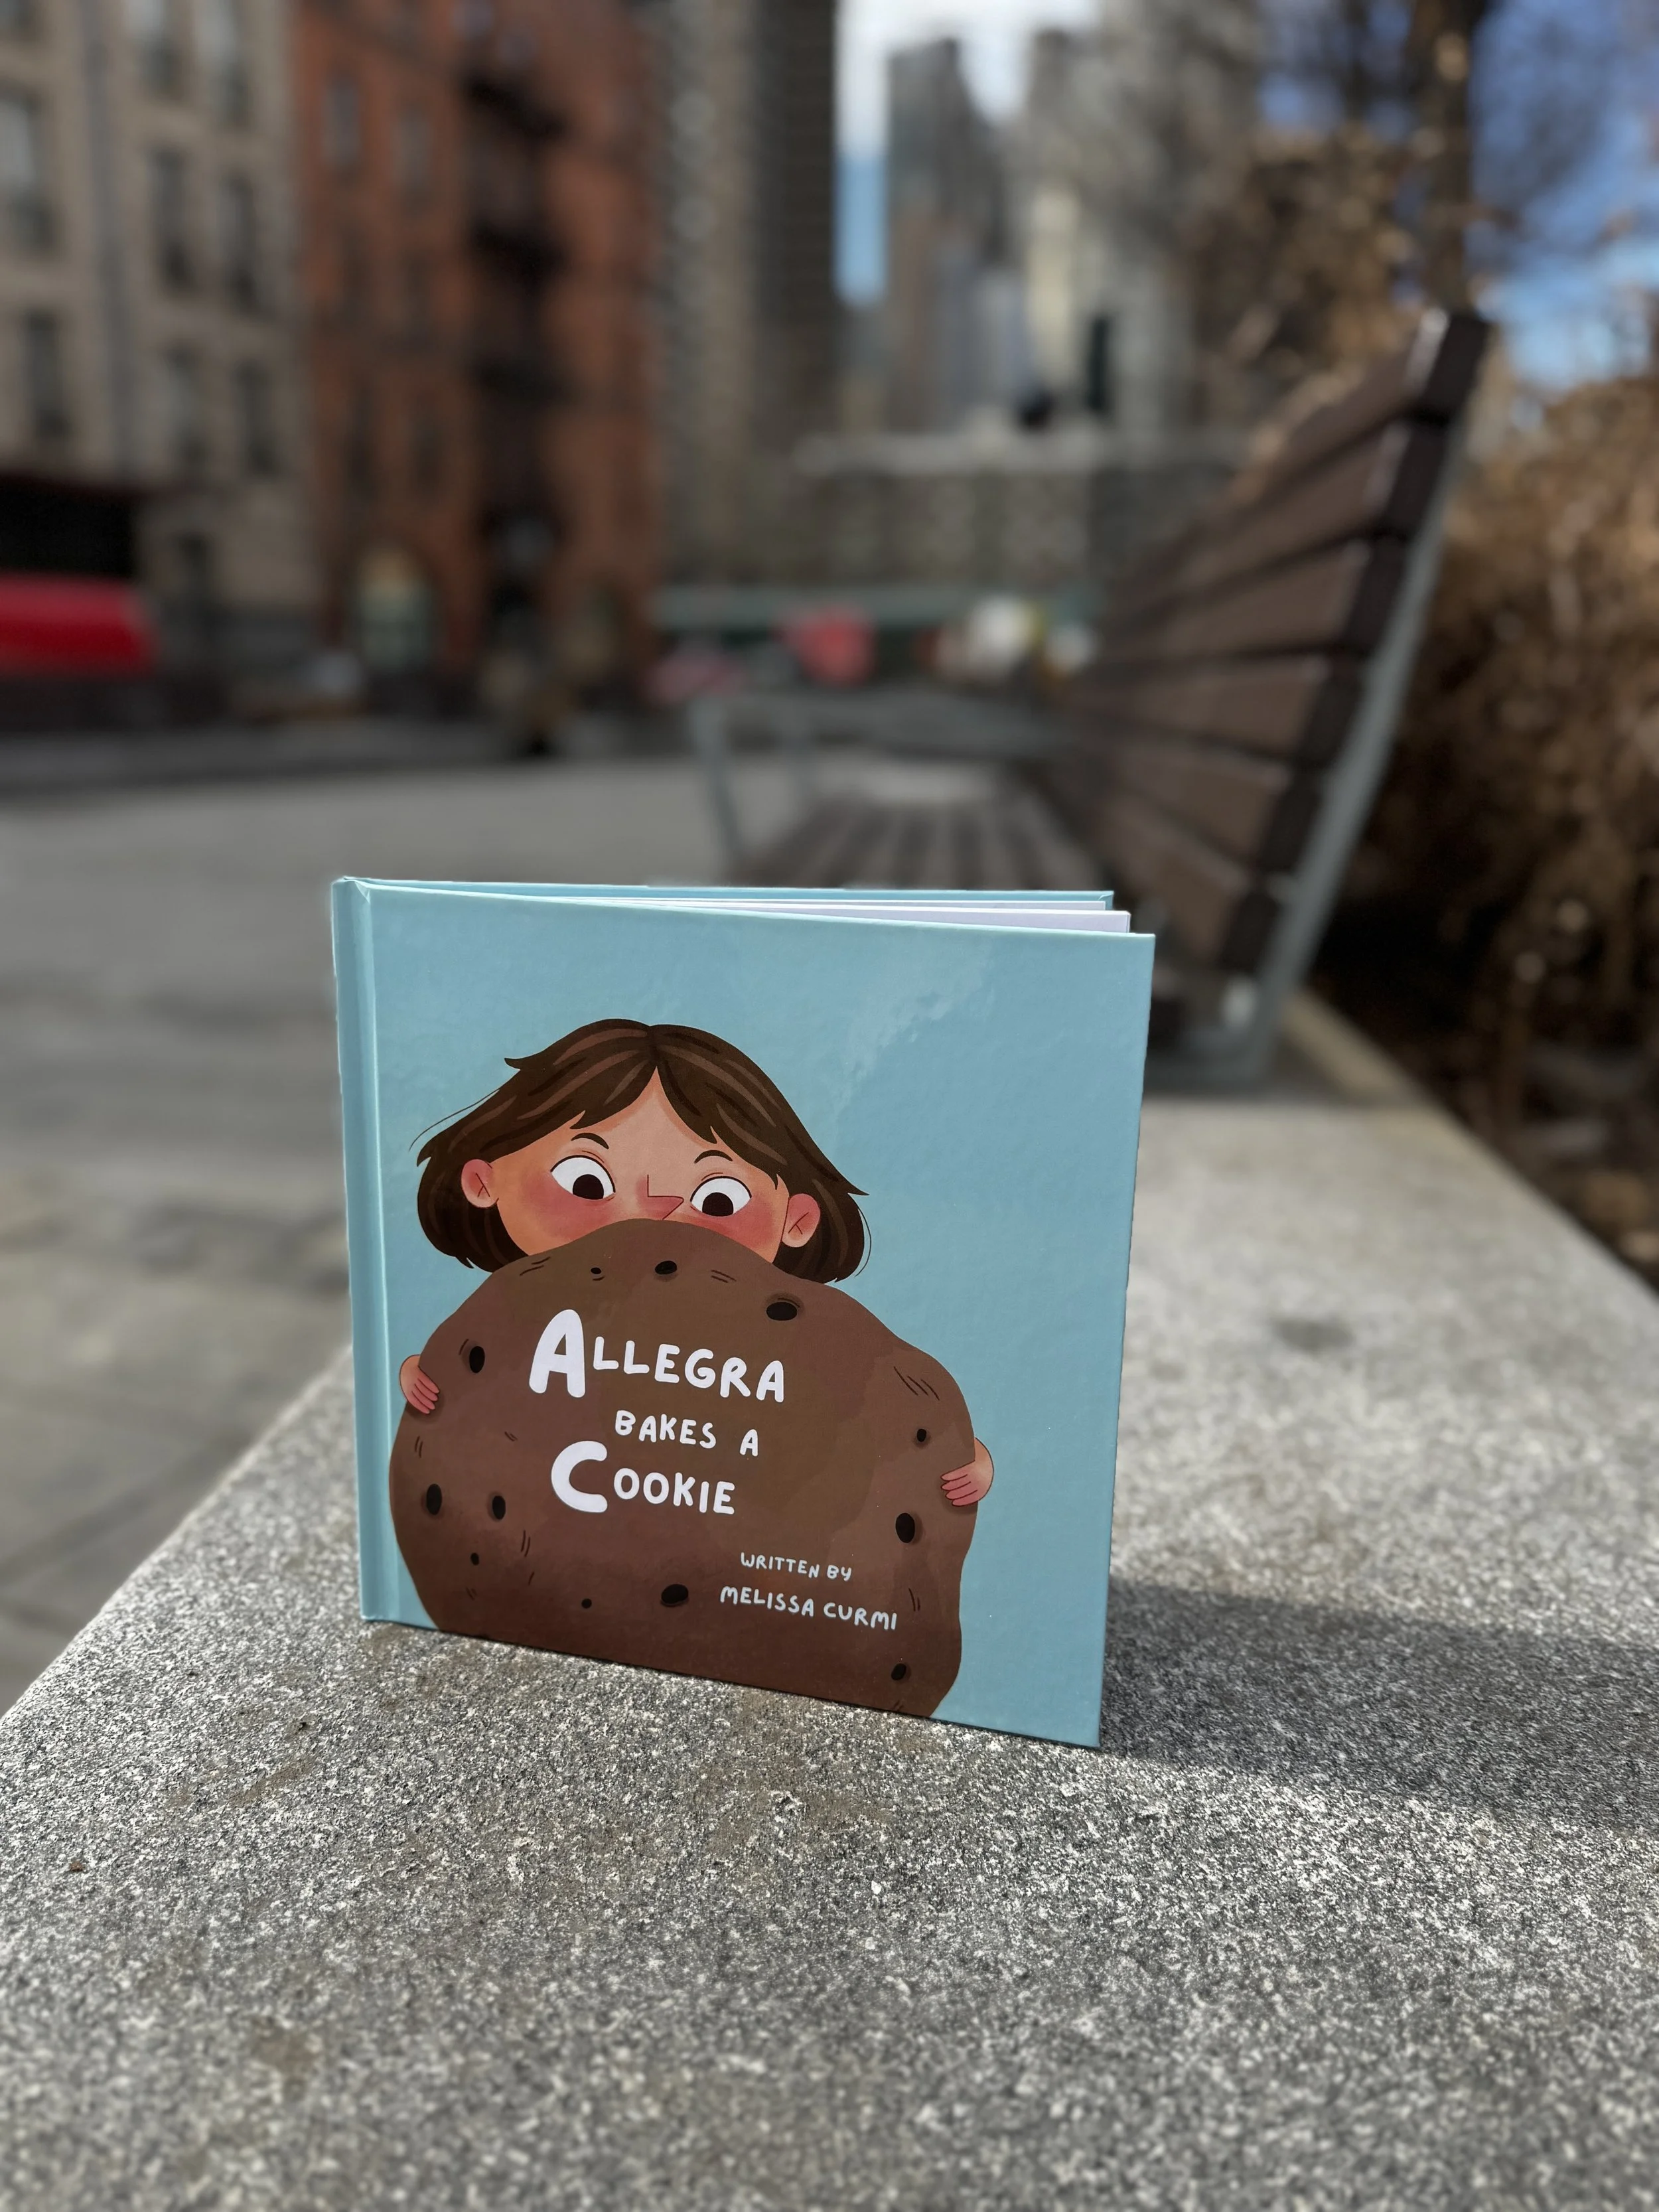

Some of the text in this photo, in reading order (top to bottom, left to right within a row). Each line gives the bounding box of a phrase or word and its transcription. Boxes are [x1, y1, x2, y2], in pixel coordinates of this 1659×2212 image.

[529, 1309, 784, 1403] ALLEGRA
[614, 1410, 758, 1457] BAKES A
[551, 1440, 735, 1514] COOKIE
[740, 1552, 852, 1582] WRITTEN BY
[720, 1586, 898, 1630] MELISSA CURMI
